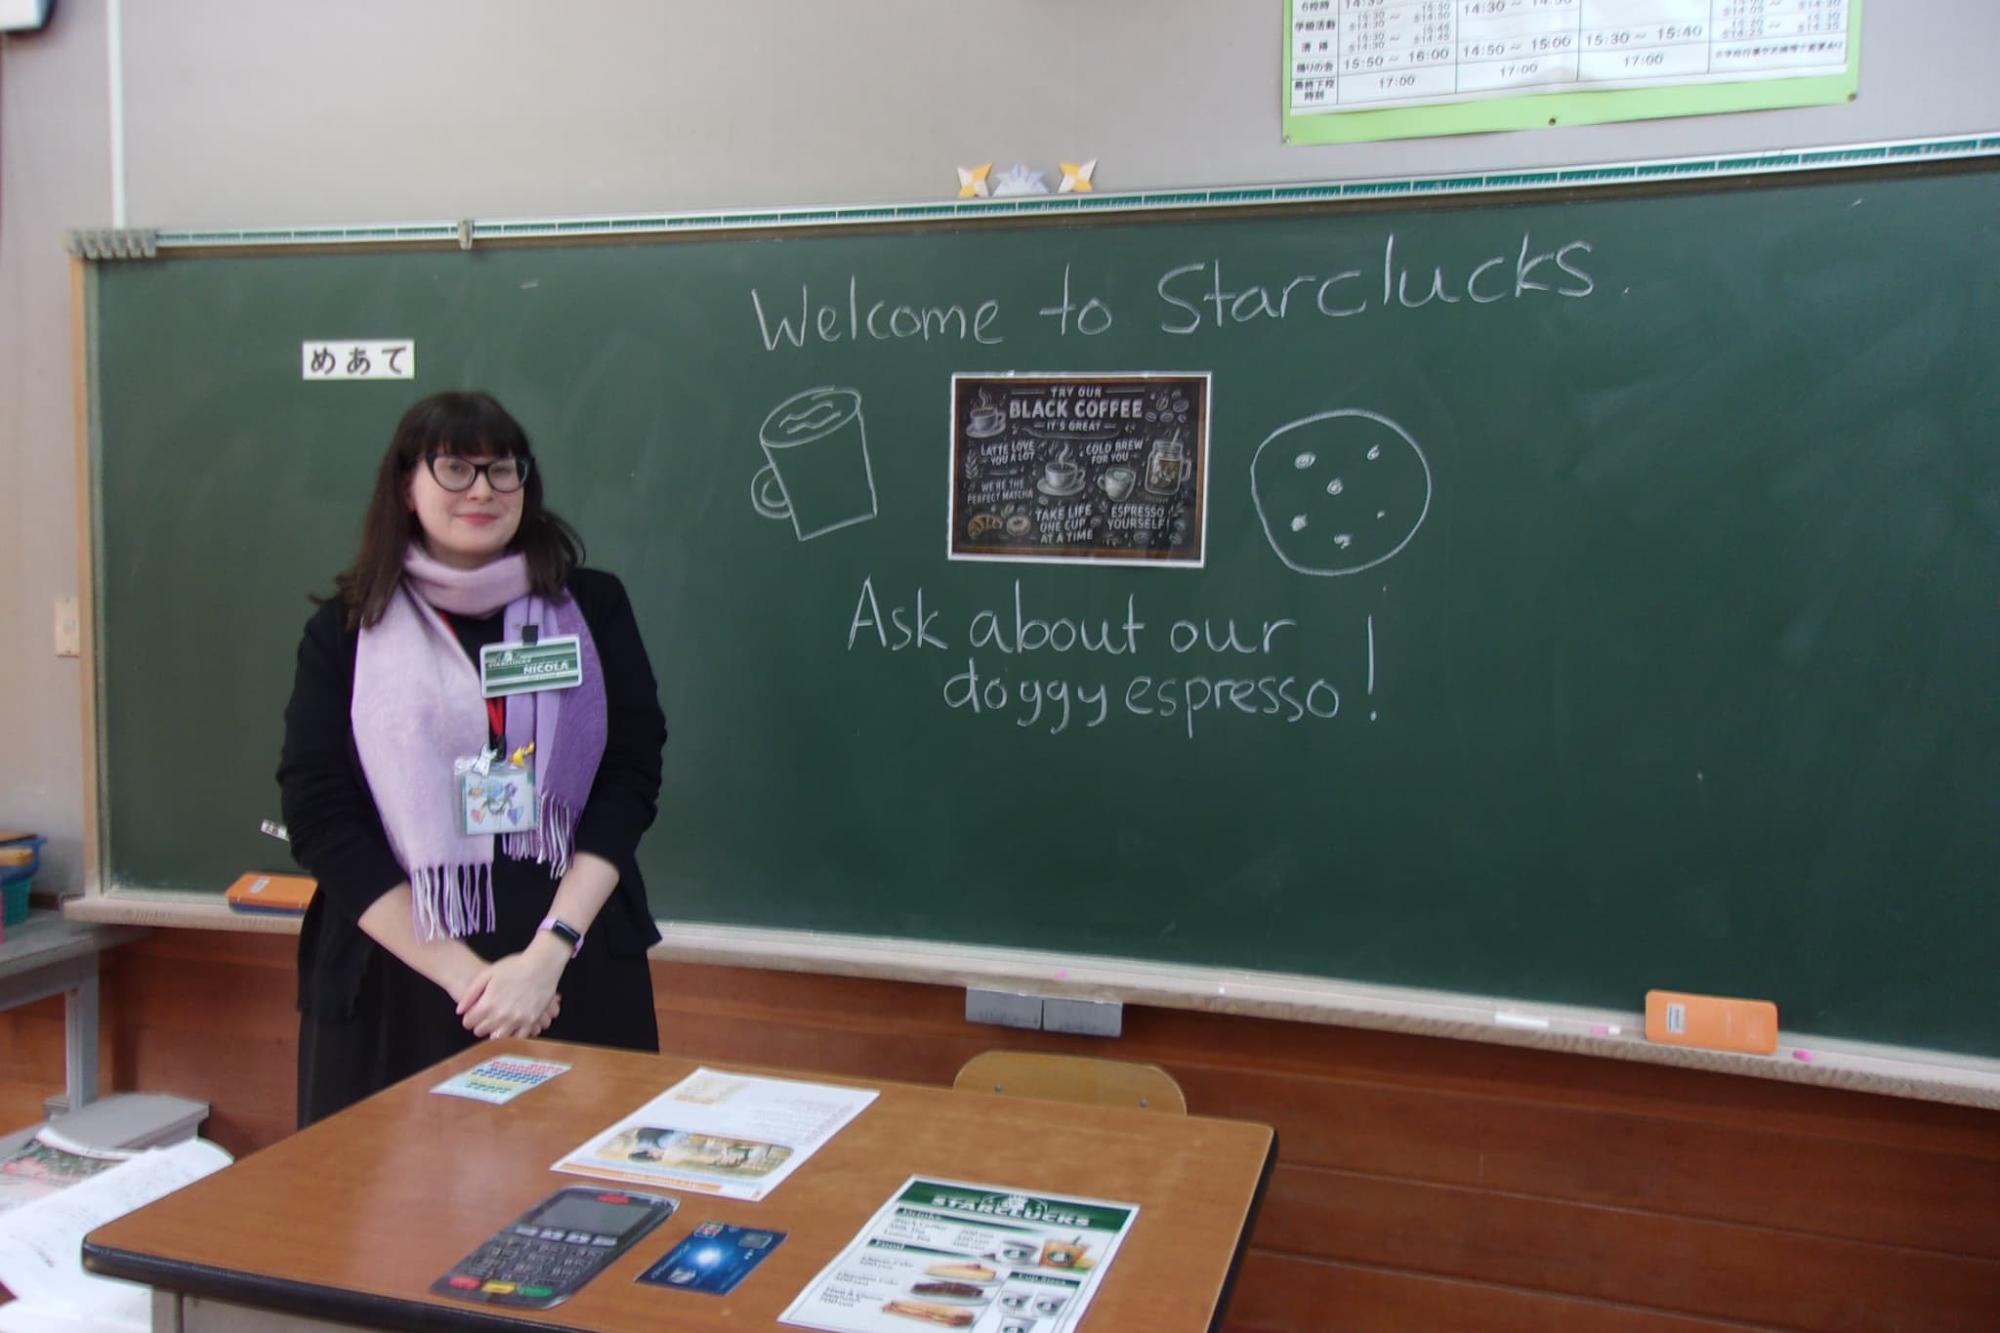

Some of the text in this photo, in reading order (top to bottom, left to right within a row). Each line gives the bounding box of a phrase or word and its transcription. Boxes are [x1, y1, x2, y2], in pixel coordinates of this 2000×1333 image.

[1587, 31, 1629, 46] 15:30
[1657, 26, 1702, 40] 15:40
[1464, 44, 1504, 58] 14:50
[1531, 34, 1571, 51] 15:00
[1344, 56, 1384, 70] 15:50
[1408, 49, 1449, 63] 16:00
[1624, 53, 1664, 68] 17:00
[1500, 64, 1539, 78] 17:00
[1378, 75, 1416, 88] 17:00
[751, 273, 1005, 351] Welcome
[1038, 262, 1113, 337] to
[310, 346, 406, 375] めあて
[1050, 386, 1102, 398] TRY OUR
[1009, 400, 1142, 419] BLACK COFFEE
[1068, 421, 1101, 431] GREAT
[981, 440, 1035, 457] LATTE LOVE
[1086, 439, 1143, 455] COLD BREW
[991, 454, 1009, 466] YOU
[1091, 452, 1129, 464] FOR YOU
[1035, 503, 1092, 521] TAKE LIFE
[1111, 505, 1164, 518] ESPRESSO
[1040, 518, 1086, 533] ONE CUP
[1041, 528, 1093, 544] AT A TIME
[847, 574, 1298, 655] Ask about our
[523, 662, 569, 675] NICOLA
[943, 657, 1108, 735] doggy
[1124, 676, 1341, 740] espresso
